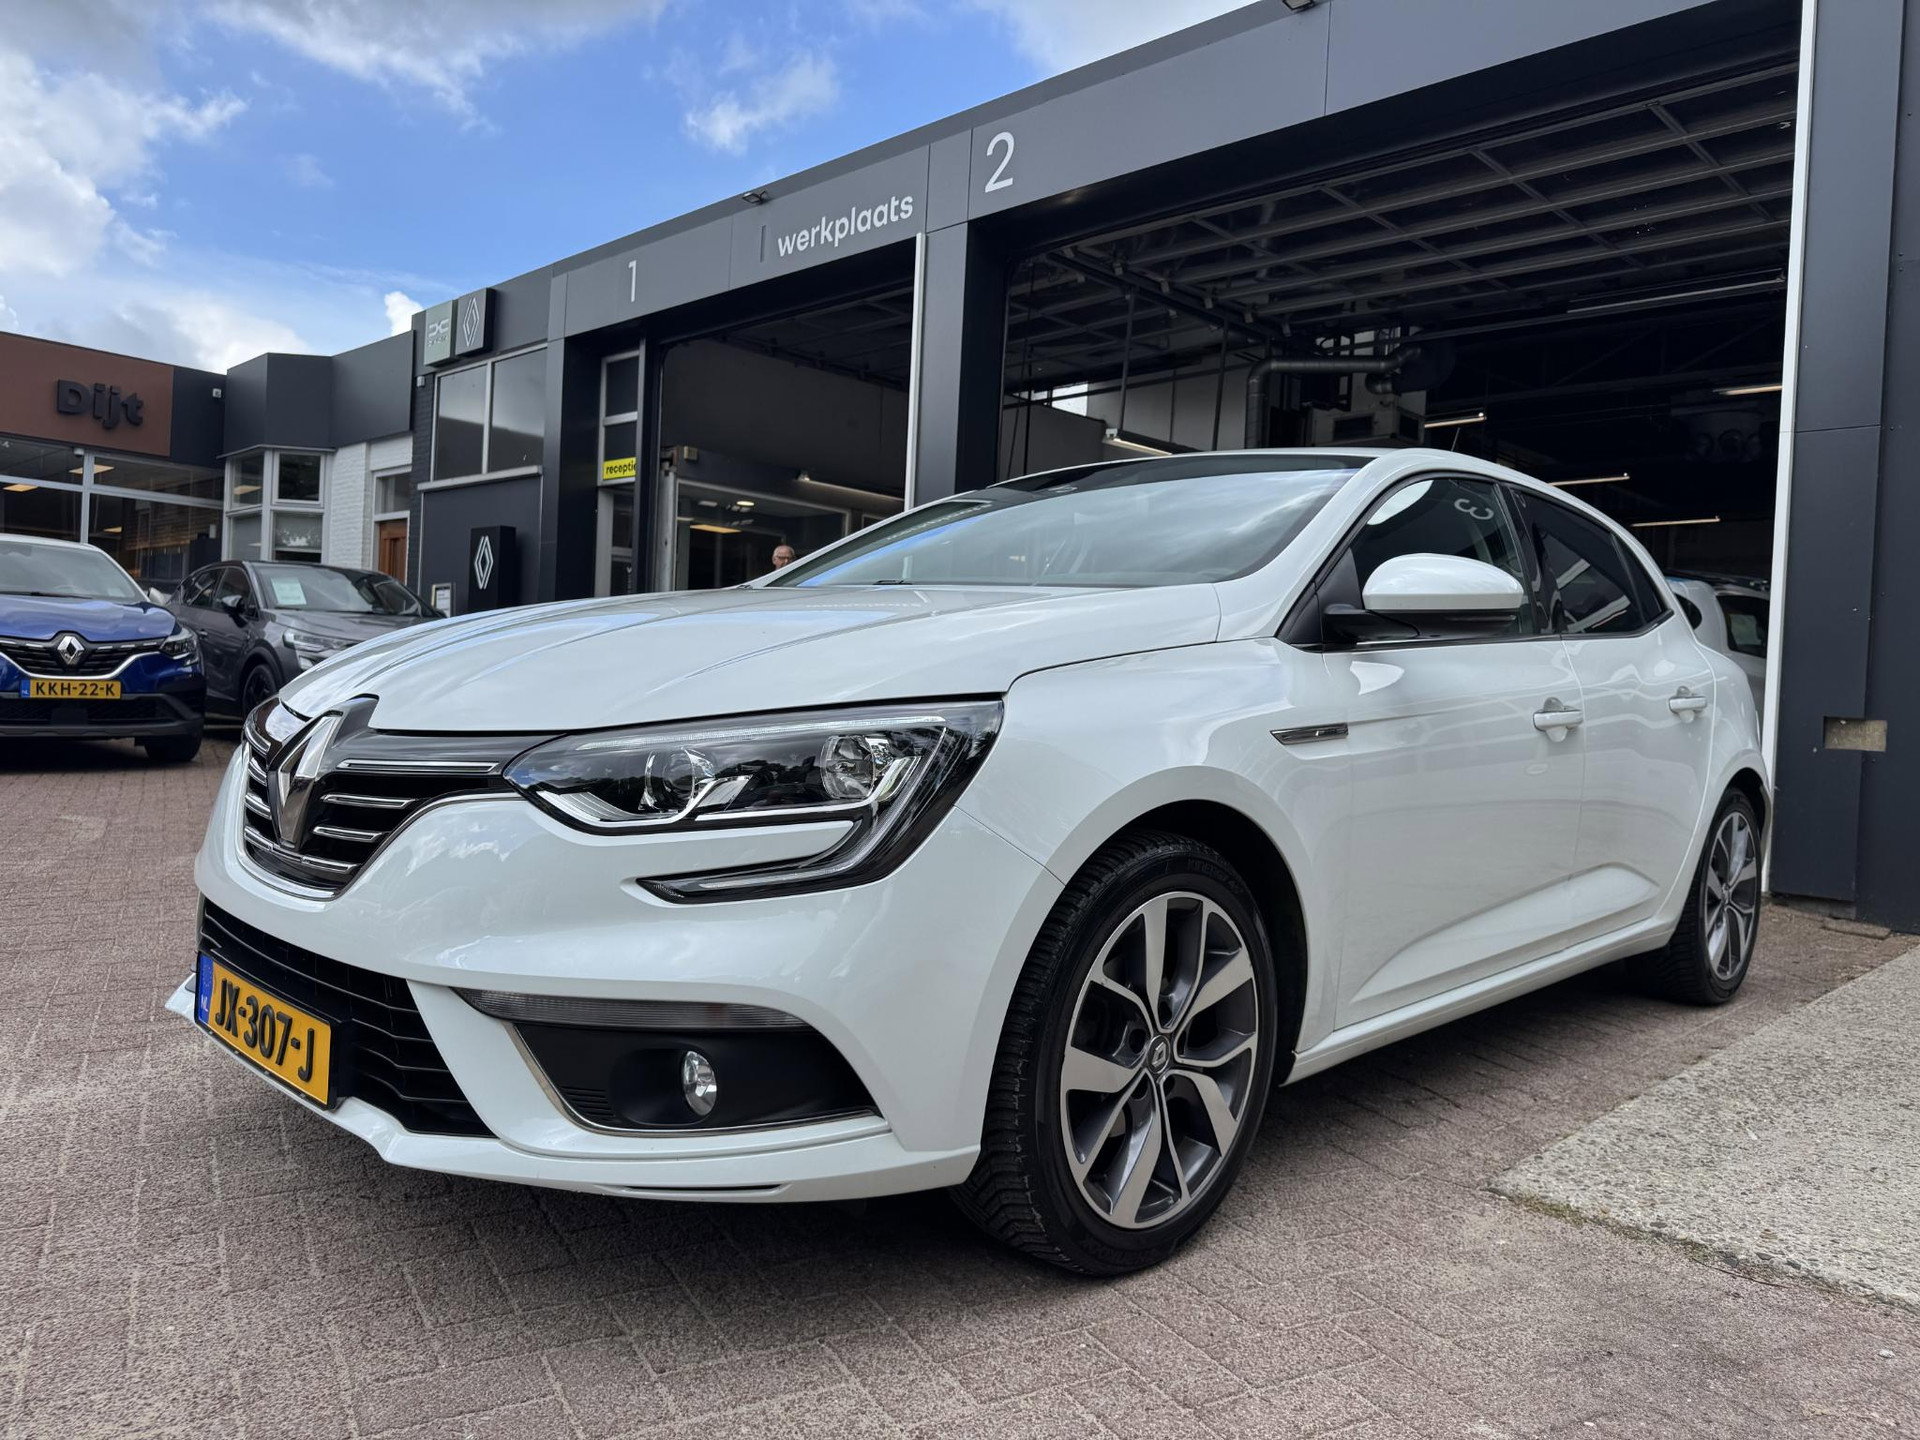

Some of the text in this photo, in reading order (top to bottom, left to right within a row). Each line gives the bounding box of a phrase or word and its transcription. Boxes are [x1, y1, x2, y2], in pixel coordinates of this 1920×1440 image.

[985, 131, 1015, 193] 2
[777, 194, 914, 257] werkplaats
[628, 260, 637, 303] 1
[56, 379, 144, 430] Dijt
[35, 682, 115, 697] KKH-22-K
[214, 977, 316, 1084] JX-307-J
